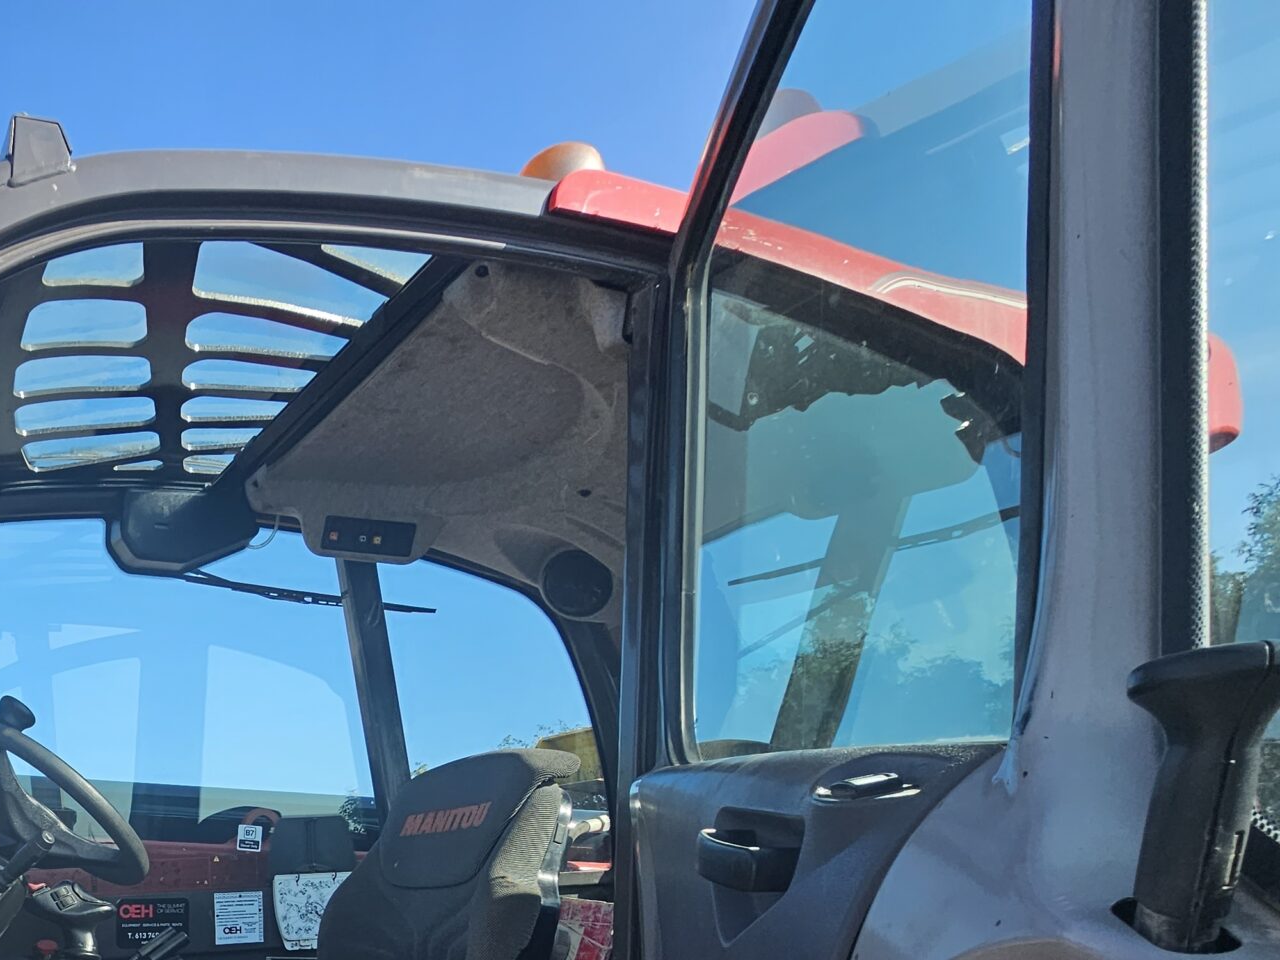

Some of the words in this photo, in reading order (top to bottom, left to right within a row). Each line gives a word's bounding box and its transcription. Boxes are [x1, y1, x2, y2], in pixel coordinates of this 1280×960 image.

[400, 801, 492, 836] MANITOU
[245, 829, 255, 837] B7
[119, 904, 154, 919] OEH
[223, 926, 242, 935] OEH
